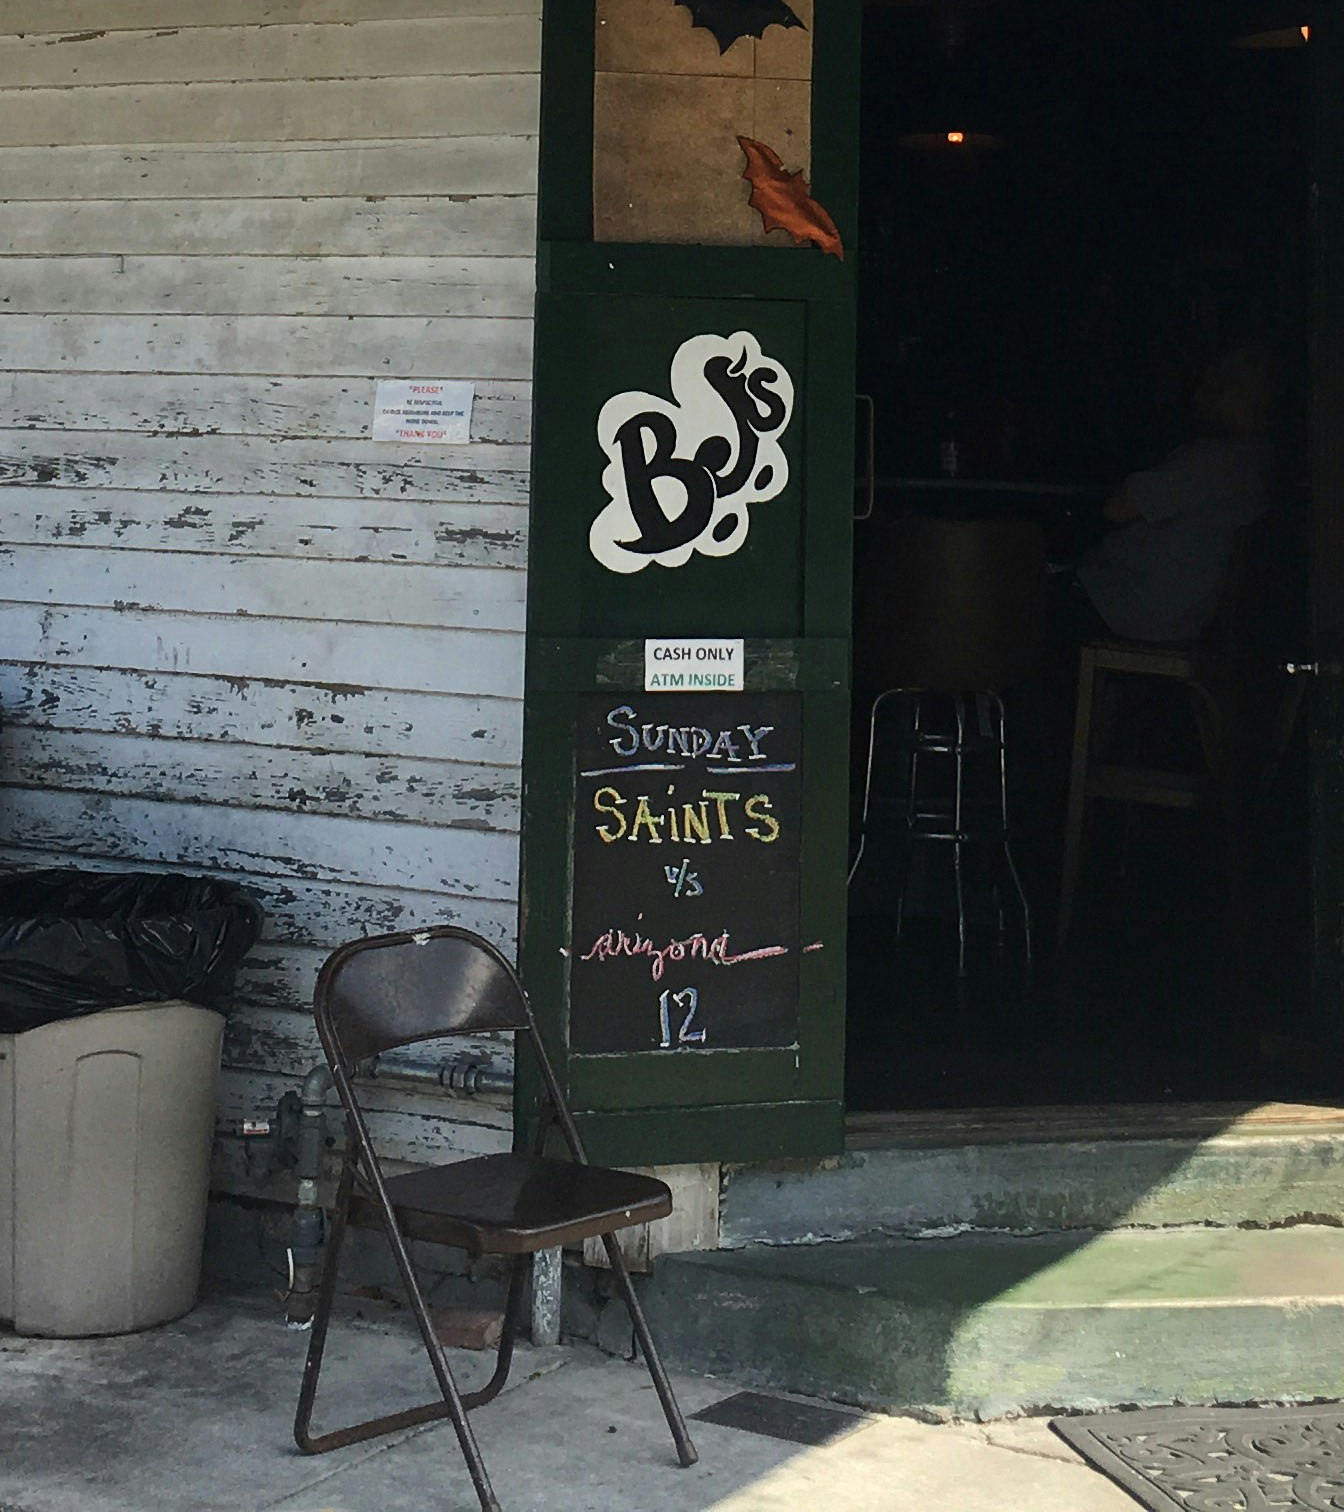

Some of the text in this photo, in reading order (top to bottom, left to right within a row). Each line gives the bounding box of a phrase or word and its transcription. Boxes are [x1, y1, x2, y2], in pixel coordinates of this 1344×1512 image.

[653, 647, 734, 660] CASH ONLY
[650, 673, 736, 686] ATM INSIDE
[659, 986, 706, 1048] 12
